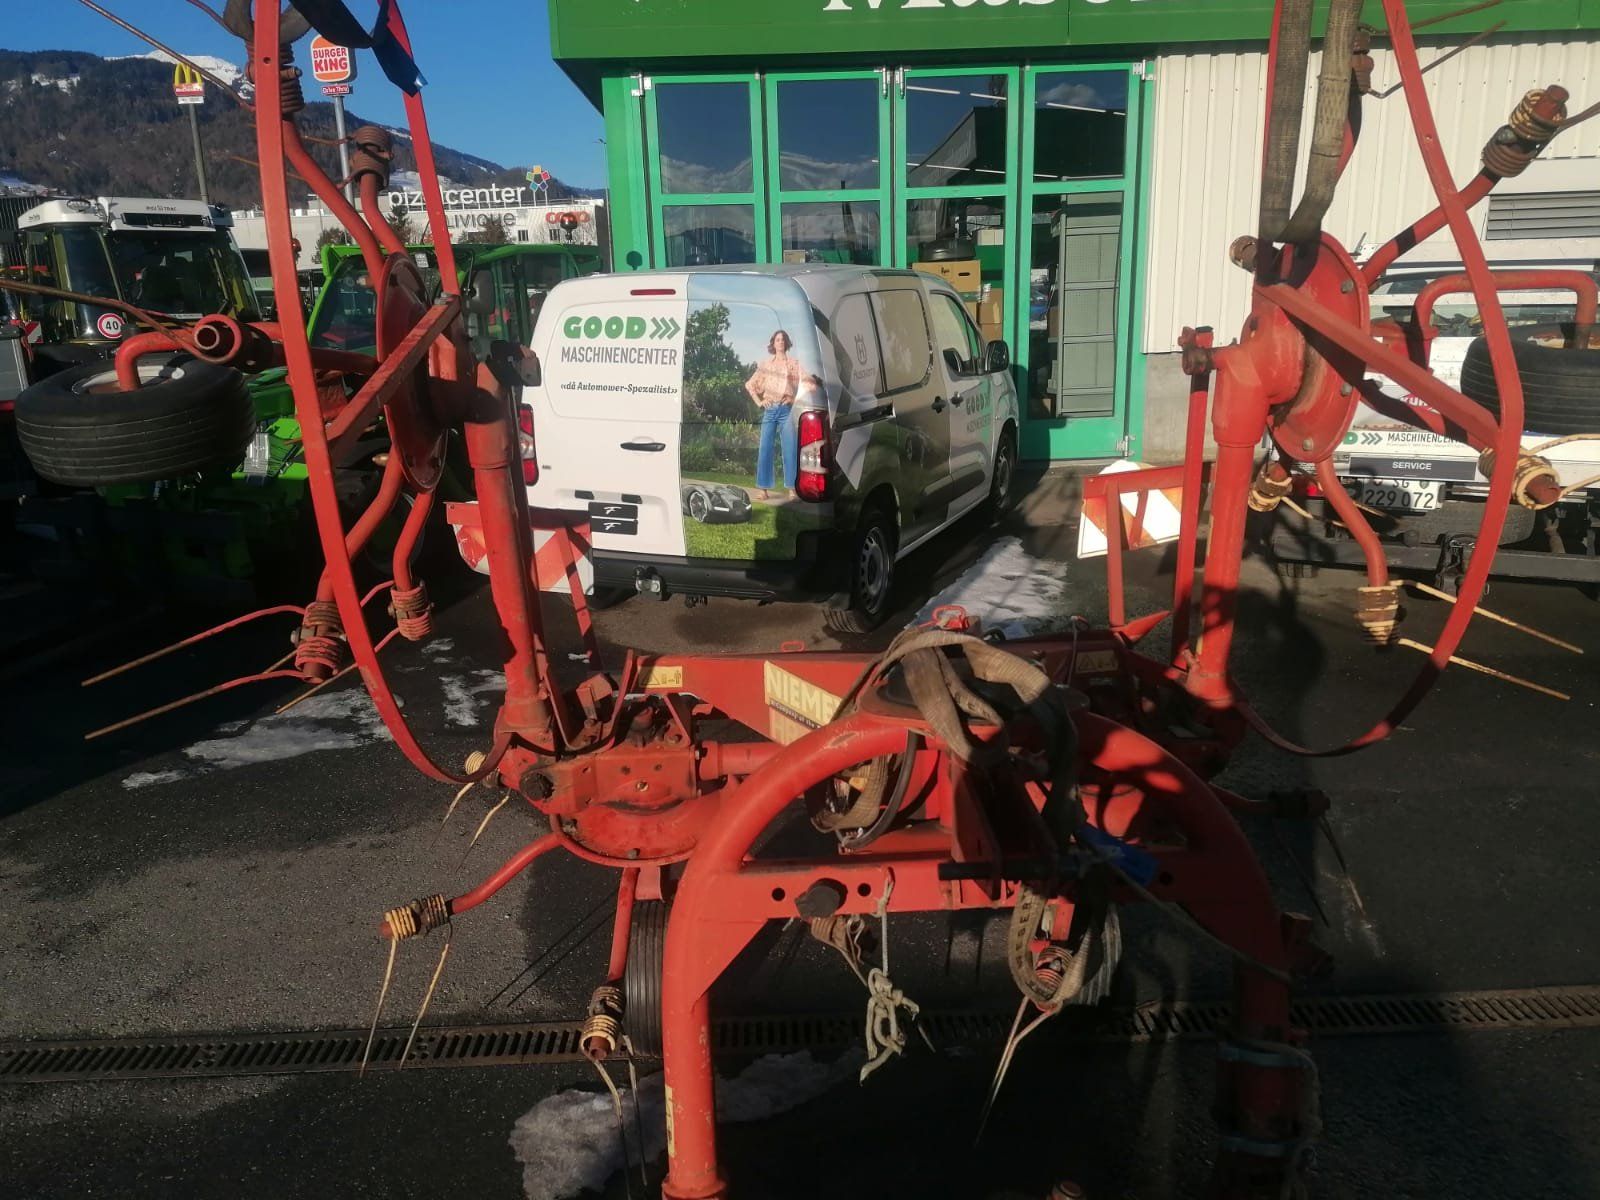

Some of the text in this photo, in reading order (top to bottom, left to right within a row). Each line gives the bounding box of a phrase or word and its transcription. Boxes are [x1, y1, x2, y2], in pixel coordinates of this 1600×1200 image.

[313, 48, 347, 59] BURGER
[314, 57, 348, 72] KING
[106, 321, 118, 330] 40
[563, 316, 647, 339] GOOD
[561, 346, 678, 366] MASCHINENCENTER
[1392, 461, 1433, 471] SERVICE
[1365, 489, 1434, 509] 229 072
